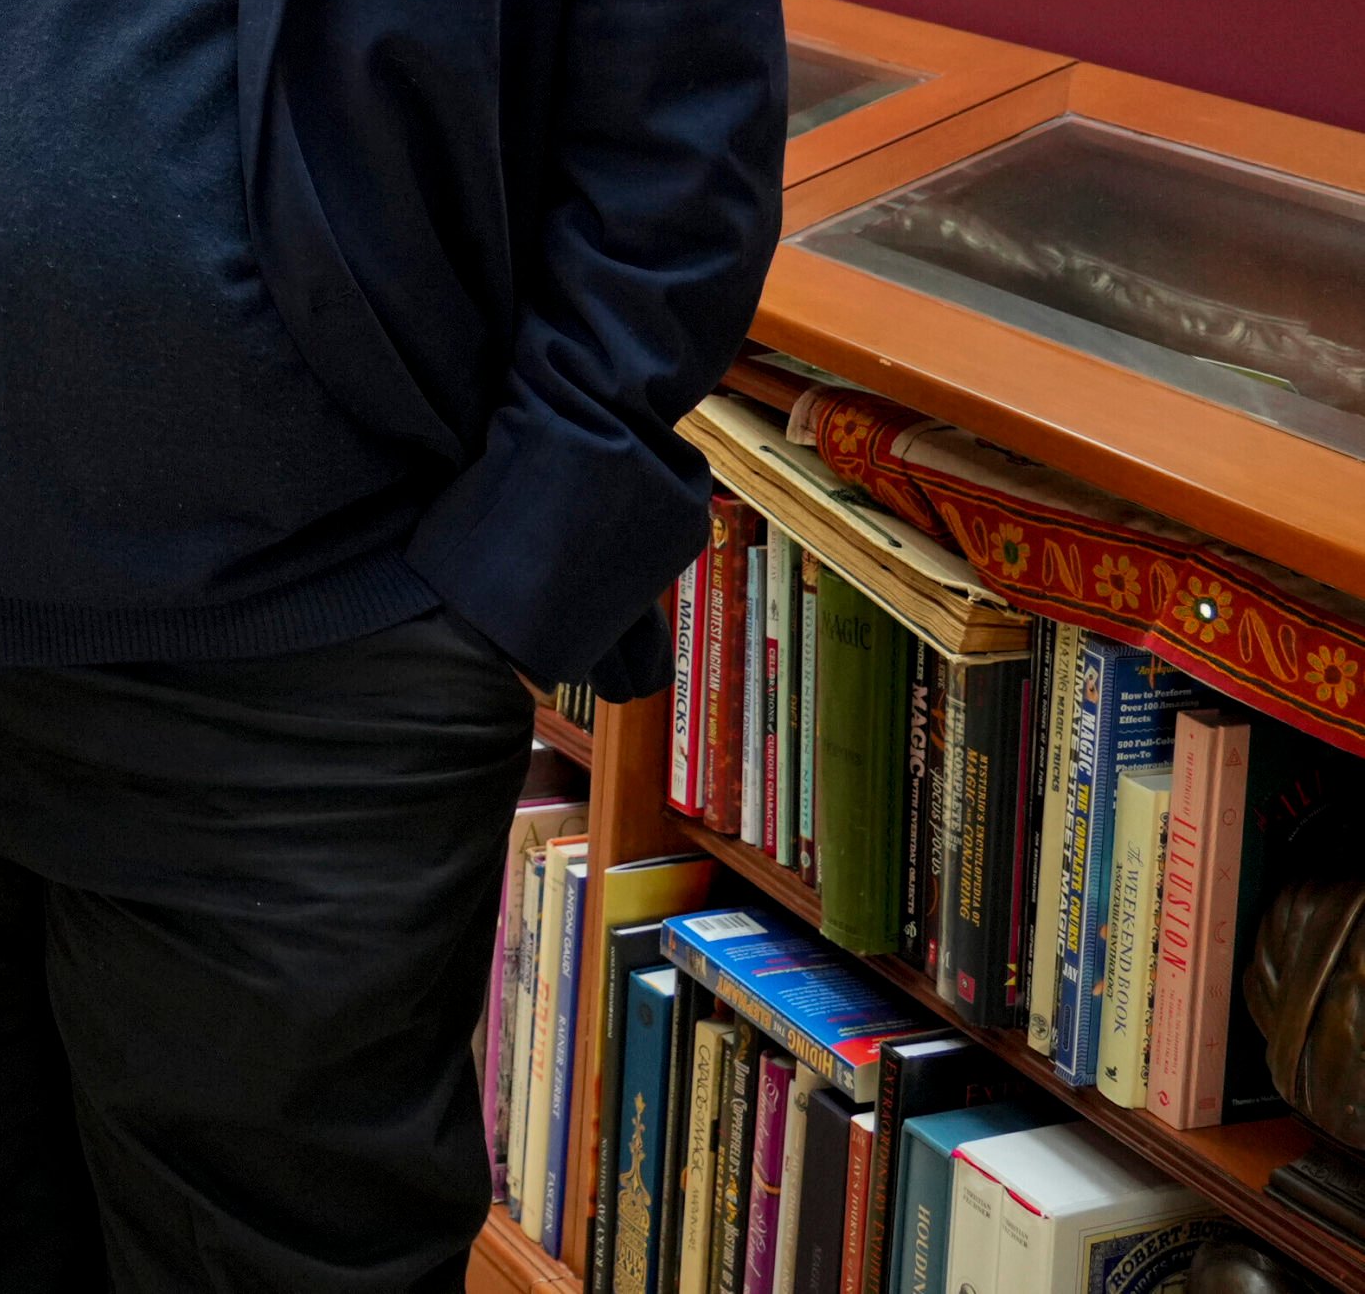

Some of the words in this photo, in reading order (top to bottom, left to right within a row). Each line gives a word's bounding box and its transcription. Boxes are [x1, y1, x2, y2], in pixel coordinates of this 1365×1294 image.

[713, 570, 722, 588] LAST
[714, 553, 723, 571] THE
[678, 598, 691, 667] MAGIC
[711, 588, 723, 641] GREATEST
[822, 610, 872, 651] MAGIC
[710, 640, 721, 692] MAGICIAN
[1057, 623, 1071, 696] AMAZING
[676, 668, 689, 737] TRICKS
[709, 701, 717, 717] THE
[1071, 628, 1089, 752] ULTIMATE
[1120, 691, 1141, 701] How
[1143, 692, 1153, 700] to
[1155, 688, 1192, 699] Perform
[1120, 703, 1141, 713] Over
[1143, 702, 1159, 712] 100
[708, 717, 717, 745] WORLD
[910, 682, 928, 778] MAGIC
[954, 707, 966, 746] THE
[1056, 696, 1065, 741] MAGIC
[1079, 707, 1096, 777] MAGIC
[1117, 740, 1134, 750] 500
[1119, 715, 1152, 725] Effects
[965, 747, 978, 807] MAGIC
[1052, 744, 1062, 794] TRICKS
[1116, 752, 1152, 762] How-To
[930, 766, 944, 820] HOCUS
[951, 746, 965, 833] COMPLETE
[977, 754, 989, 822] MYSTERIO'S
[1063, 758, 1079, 867] STREET
[1076, 784, 1089, 814] THE
[909, 809, 917, 865] EVERYDAY
[929, 819, 943, 876] POCUS
[1073, 815, 1087, 894] COMPLETE
[1126, 840, 1142, 867] The
[960, 823, 974, 922] CONJURING
[972, 823, 985, 912] ENCYCLOPEDIA
[1163, 816, 1198, 973] ILLUSION
[566, 884, 576, 935] ANTONI
[972, 913, 980, 927] OF
[1057, 868, 1071, 958] MAGIC
[1067, 895, 1081, 955] COURSE
[1120, 867, 1139, 971] WEEK-END
[1062, 962, 1079, 984] JAY
[717, 975, 772, 1031] ELEPHANT
[772, 1021, 788, 1038] THE
[1114, 973, 1131, 1036] BOOK
[557, 1013, 566, 1065] RAINER
[788, 1029, 835, 1078] HIDING
[553, 1066, 565, 1120] ZERBST
[733, 1058, 750, 1096] DAVID
[690, 1126, 705, 1184] MAGIC
[729, 1097, 748, 1176] COPPERFIELD'S
[875, 1059, 897, 1213] EXTRAORDINARY
[852, 1155, 862, 1191] JAY'S
[545, 1170, 555, 1233] TASCHEN
[597, 1203, 607, 1223] JAY
[849, 1192, 860, 1254] JOURNAL
[595, 1229, 607, 1267] RICKY
[723, 1218, 739, 1271] HISTORY
[868, 1219, 885, 1294] EXHIBIT
[914, 1203, 930, 1294] HOUDIN
[1110, 1224, 1183, 1289] ROBERT
